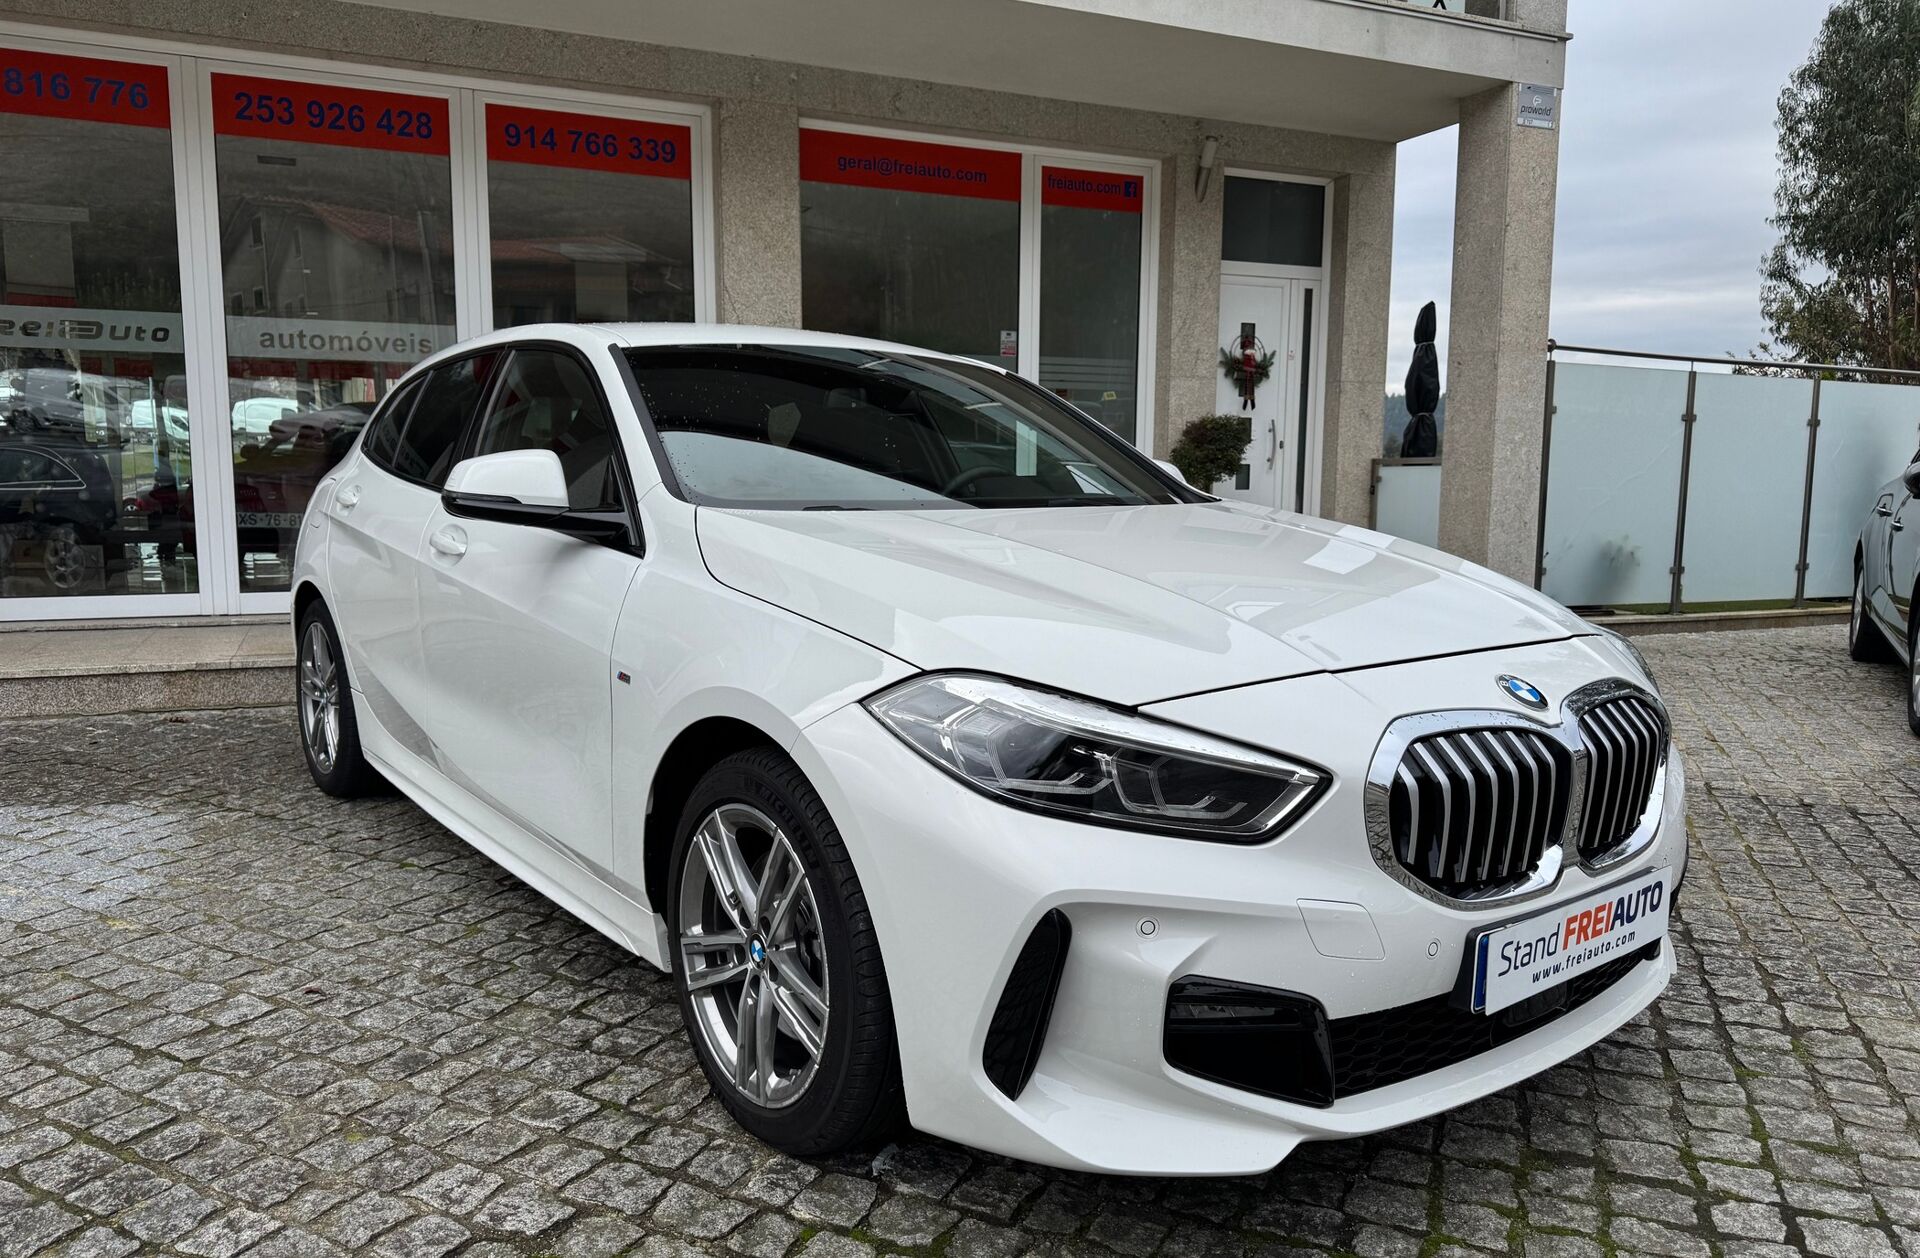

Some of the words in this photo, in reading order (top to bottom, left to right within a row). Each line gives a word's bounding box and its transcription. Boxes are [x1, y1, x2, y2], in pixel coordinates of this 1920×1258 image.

[4, 67, 71, 100] 816
[84, 76, 149, 110] 776
[234, 91, 296, 125] 253
[306, 100, 366, 133] 926
[376, 108, 433, 140] 428
[504, 123, 557, 151] 914
[567, 130, 618, 157] 766
[628, 136, 677, 164] 339
[837, 154, 988, 184] geral@freiauto.com
[1047, 175, 1122, 194] freiauto.com
[259, 329, 433, 354] automóveis
[1498, 922, 1561, 978] Stand
[1563, 880, 1664, 951] FREIAUTO
[1532, 930, 1636, 984] www.freiauto.com
